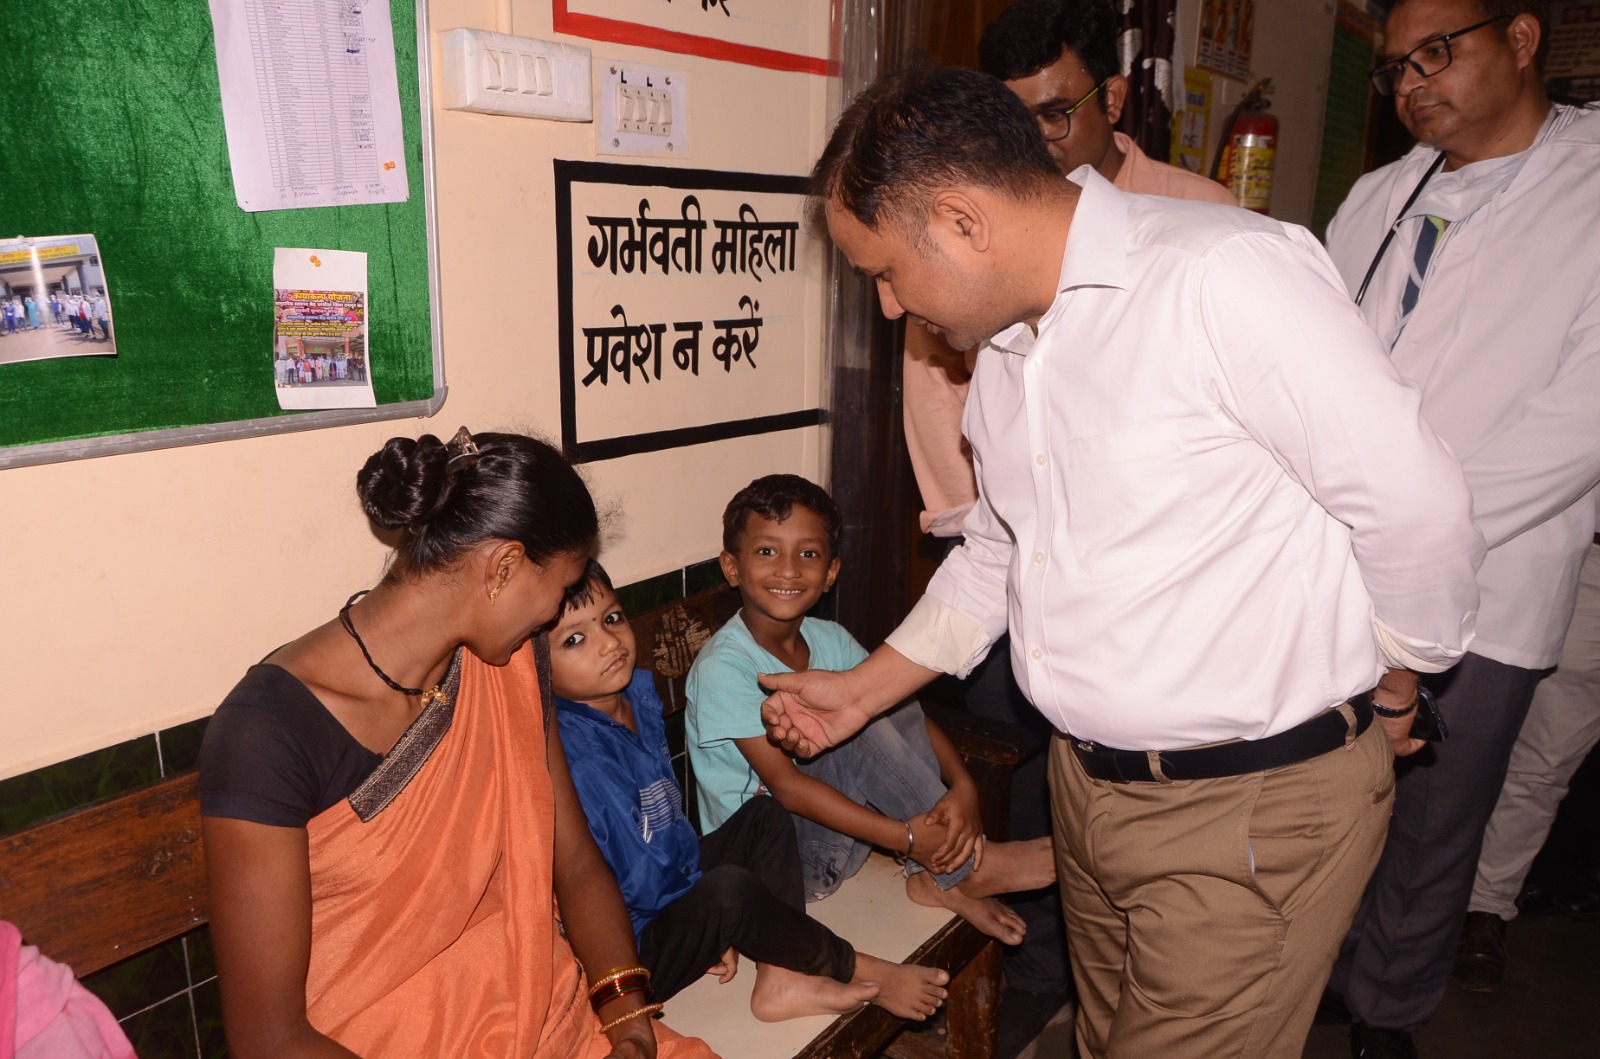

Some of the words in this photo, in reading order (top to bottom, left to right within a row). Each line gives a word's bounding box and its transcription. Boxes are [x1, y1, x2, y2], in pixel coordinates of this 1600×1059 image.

[620, 71, 628, 84] L
[646, 76, 653, 87] L
[586, 194, 707, 275] गर्भवती
[711, 203, 799, 282] महिला
[328, 292, 351, 301] योजना
[582, 304, 666, 387] प्रवेश
[673, 321, 703, 377] न
[712, 295, 763, 374] करें
